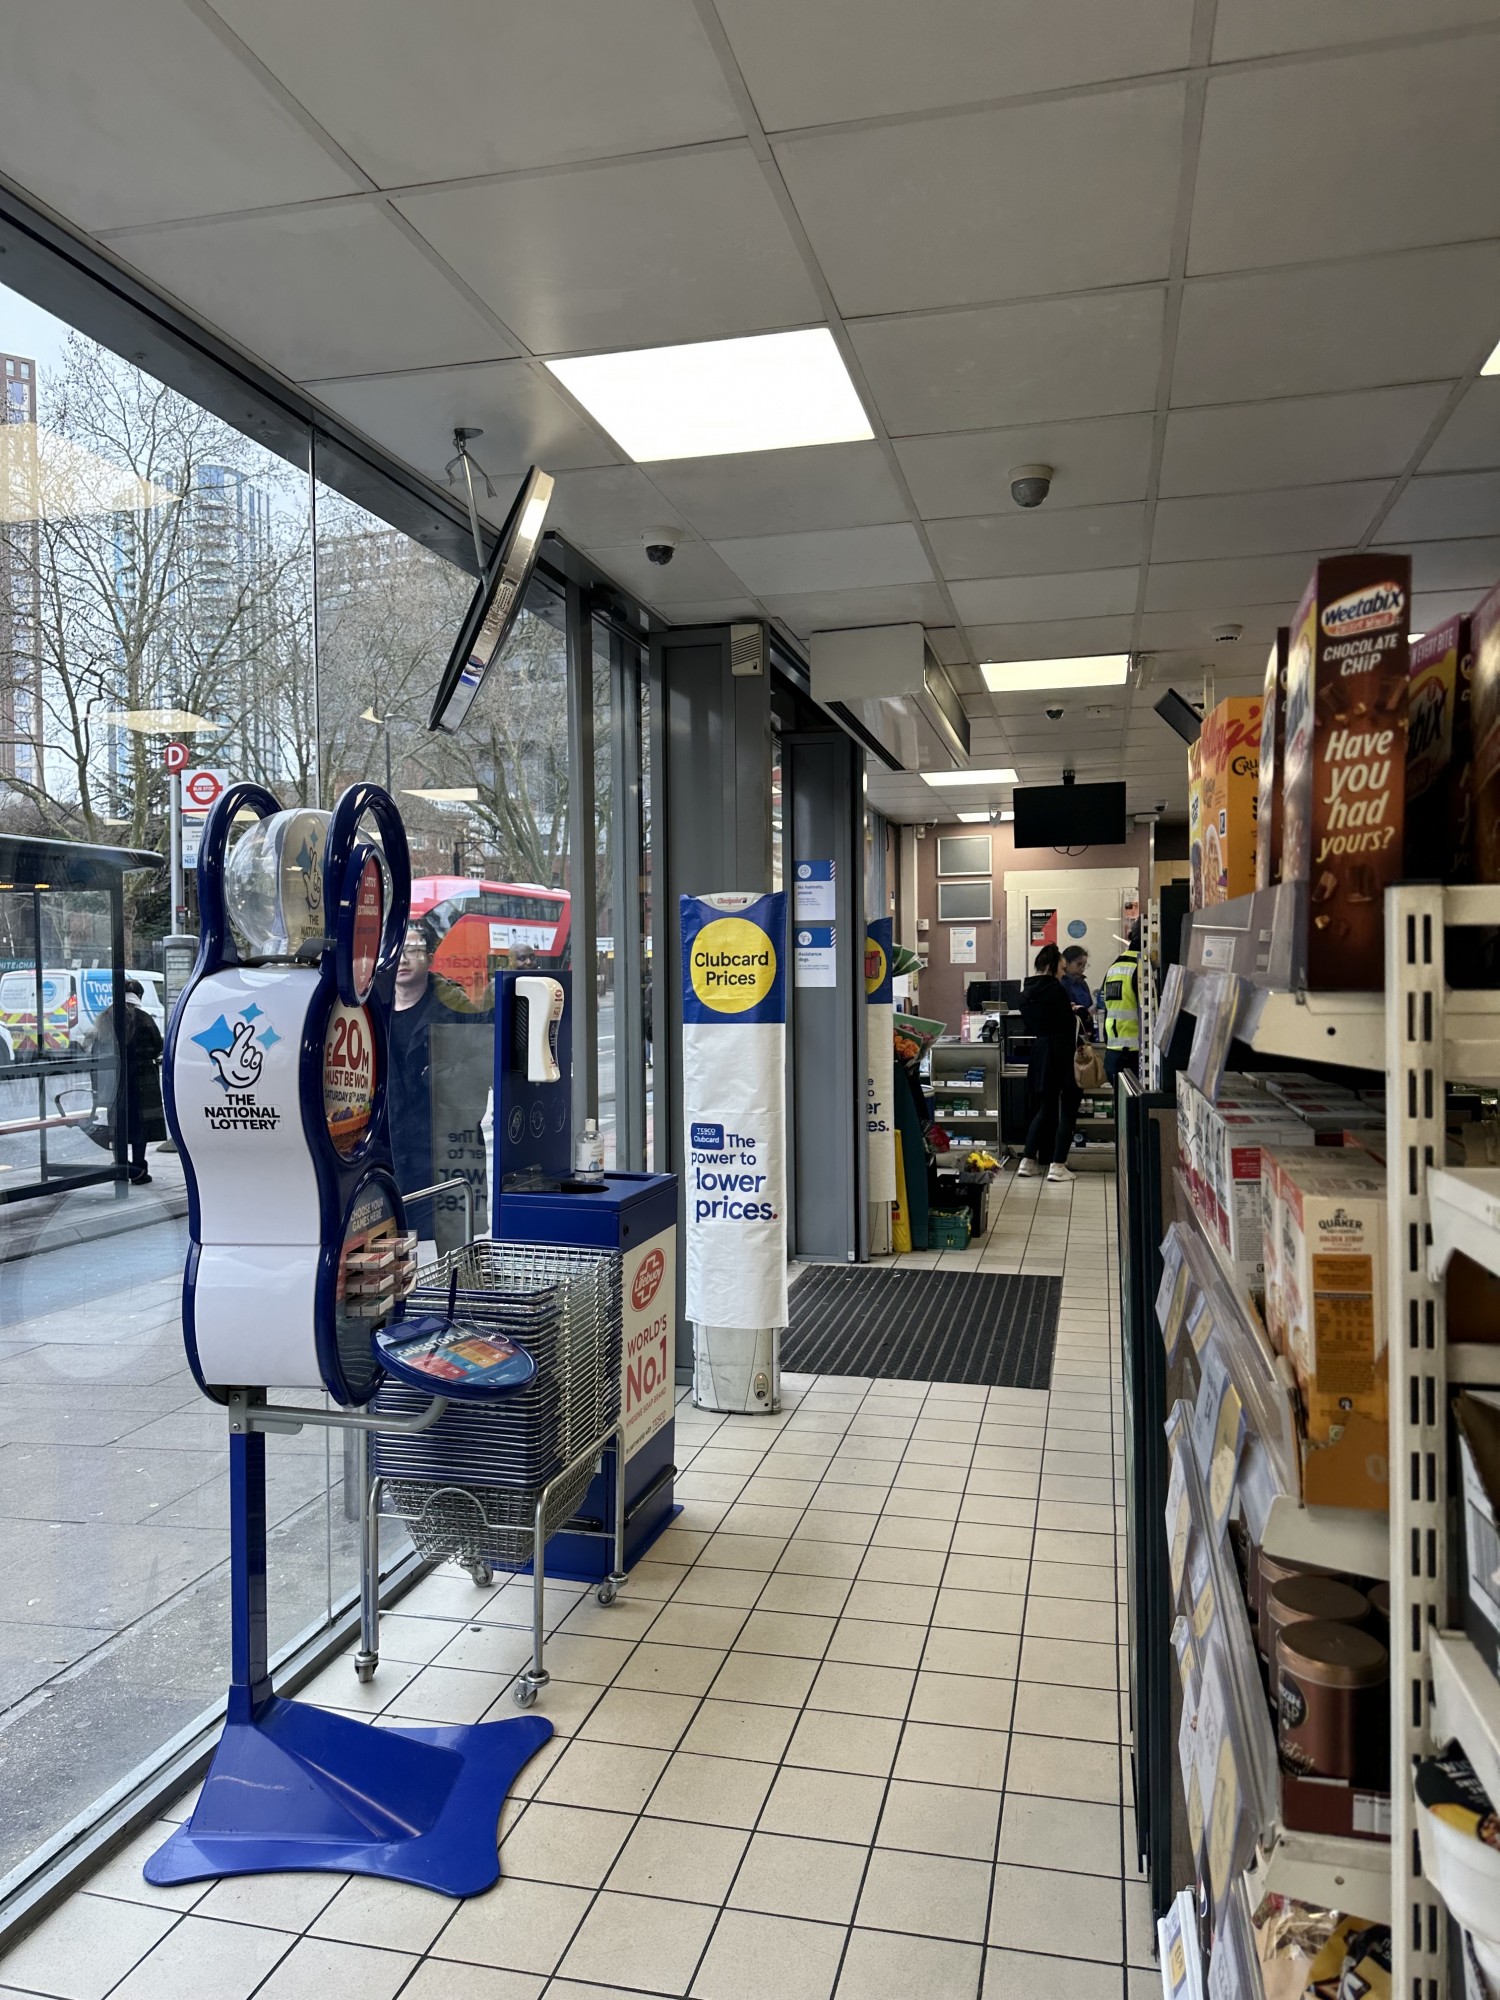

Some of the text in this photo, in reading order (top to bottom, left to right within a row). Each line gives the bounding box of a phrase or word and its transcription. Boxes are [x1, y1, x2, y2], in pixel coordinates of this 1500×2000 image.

[1324, 591, 1402, 625] Weetabix
[1323, 633, 1399, 661] CHOCOLATE
[1417, 635, 1437, 664] EVERY
[1437, 627, 1454, 652] BITE
[1324, 729, 1394, 763] Have
[168, 746, 184, 766] D
[1323, 760, 1391, 804] you
[1326, 790, 1390, 831] had
[1316, 826, 1395, 863] yours?
[308, 914, 320, 926] THE
[300, 927, 325, 939] NATIONA
[694, 951, 769, 967] Clubcard
[706, 971, 756, 986] Prices
[325, 1068, 344, 1087] MUST
[344, 1071, 354, 1087] BE
[225, 1094, 256, 1106] THE
[324, 1089, 348, 1103] SATURDAY
[204, 1106, 281, 1118] NATIONAL
[210, 1119, 277, 1130] LOTTERY
[696, 1127, 716, 1135] TESCO
[693, 1135, 720, 1144] Clubcard
[726, 1134, 756, 1148] The
[691, 1151, 757, 1167] power to
[696, 1167, 767, 1193] lower
[350, 1203, 371, 1222] CHOOSE
[696, 1195, 778, 1224] prices.
[352, 1214, 370, 1232] GAMES
[1318, 1218, 1363, 1231] QUAKER
[634, 1266, 663, 1293] Lifebuoy
[627, 1314, 667, 1359] WORLD'S
[396, 1339, 437, 1358] GAMES
[626, 1335, 667, 1414] No.1
[651, 1409, 667, 1428] TESCO
